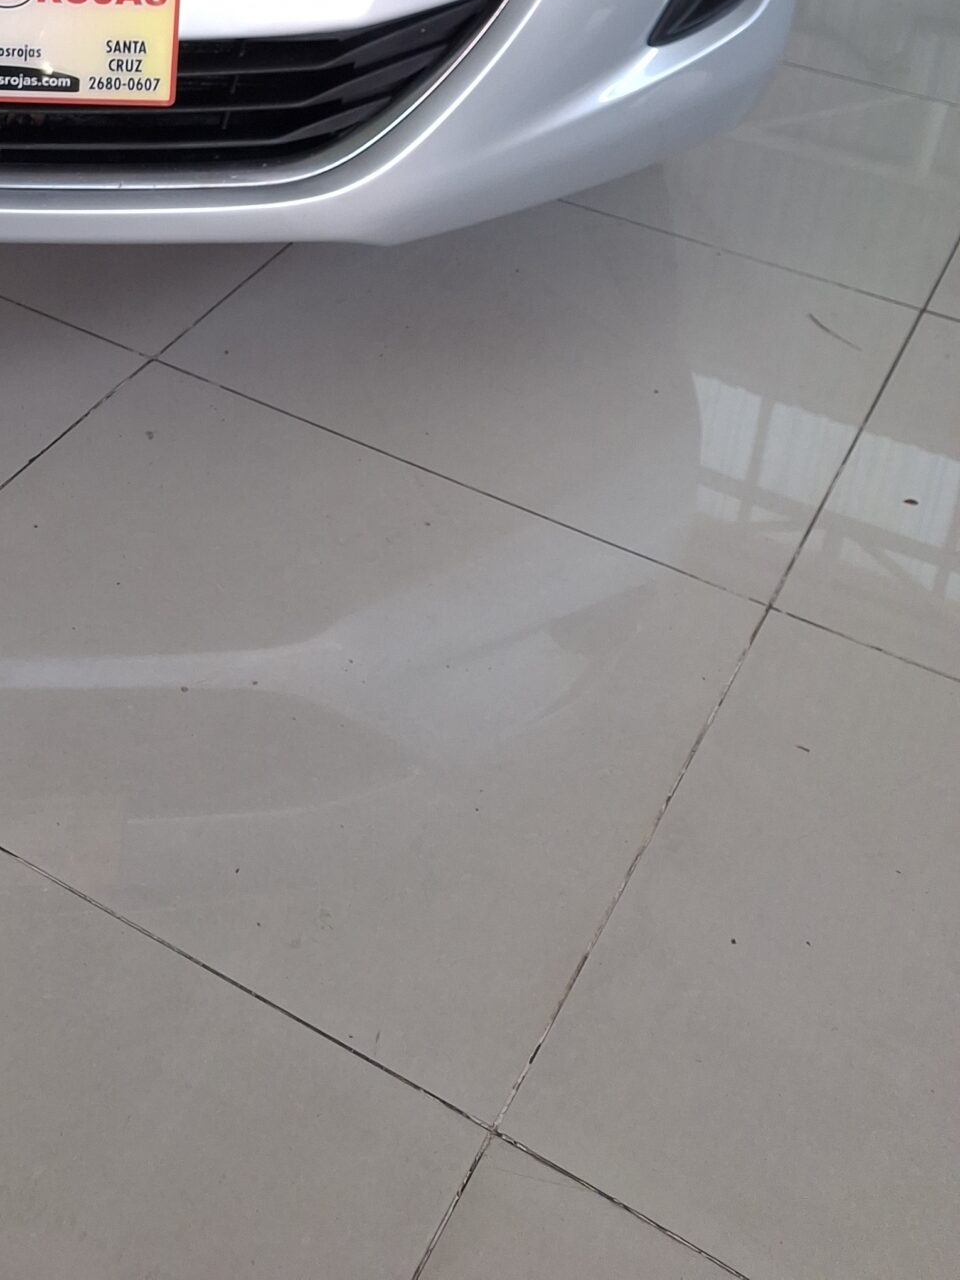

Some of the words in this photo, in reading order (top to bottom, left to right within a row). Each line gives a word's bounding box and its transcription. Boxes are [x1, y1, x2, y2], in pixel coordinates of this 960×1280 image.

[106, 39, 147, 55] SANTA
[108, 59, 142, 73] CRUZ
[88, 76, 161, 92] 2680-0607
